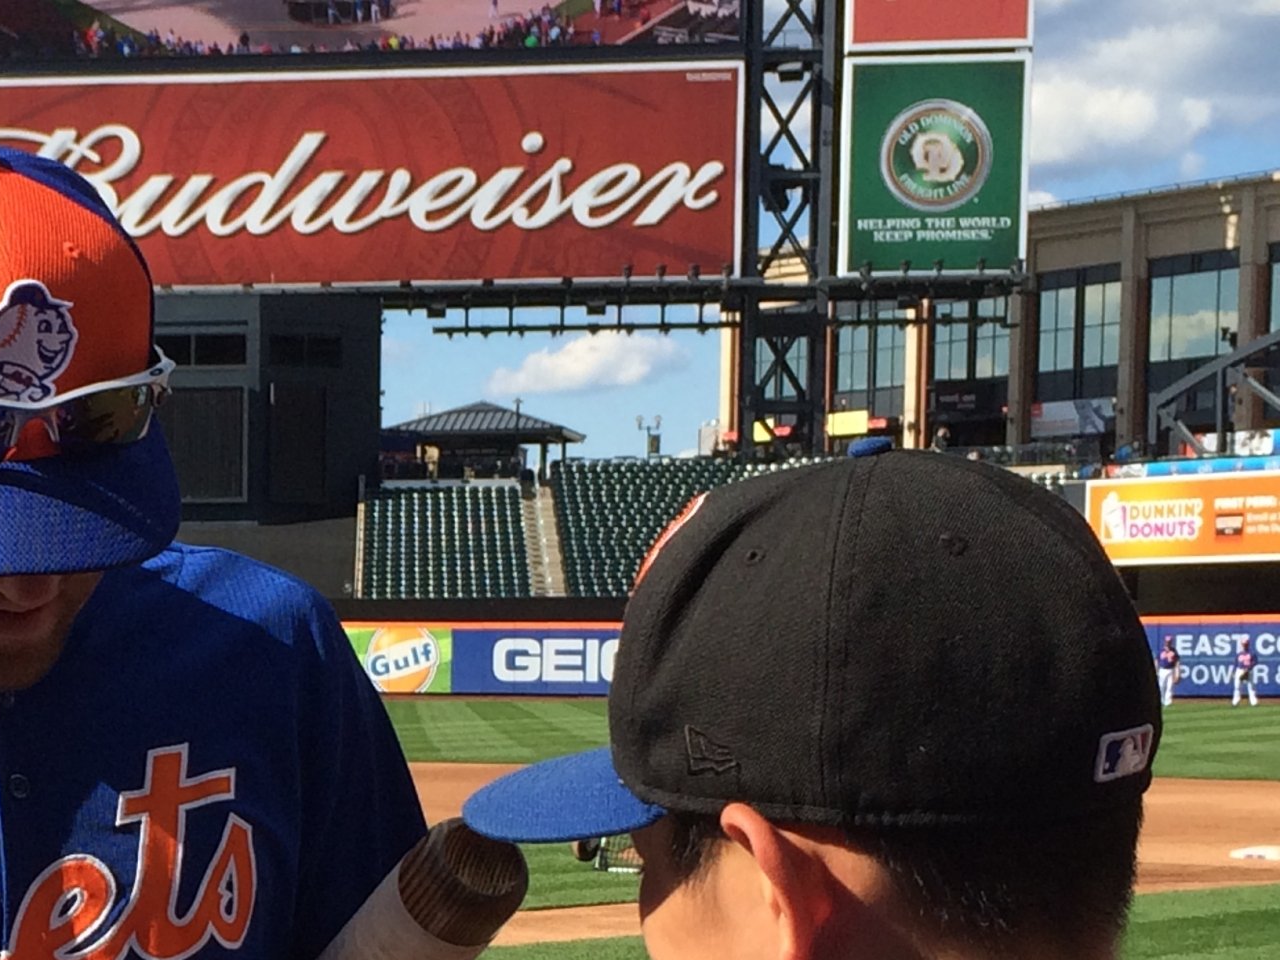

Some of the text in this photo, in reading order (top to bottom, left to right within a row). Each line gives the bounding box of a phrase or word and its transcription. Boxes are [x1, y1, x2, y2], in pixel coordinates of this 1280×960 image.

[898, 113, 974, 145] OLD DOMINION
[857, 216, 1012, 231] HELPING THE WORLD
[873, 230, 913, 242] KEEP
[1130, 502, 1200, 519] DUNKIN'
[1130, 520, 1196, 538] DONUTS
[1176, 633, 1250, 655] EAST
[370, 642, 433, 677] Gulf
[1179, 664, 1269, 684] POWR
